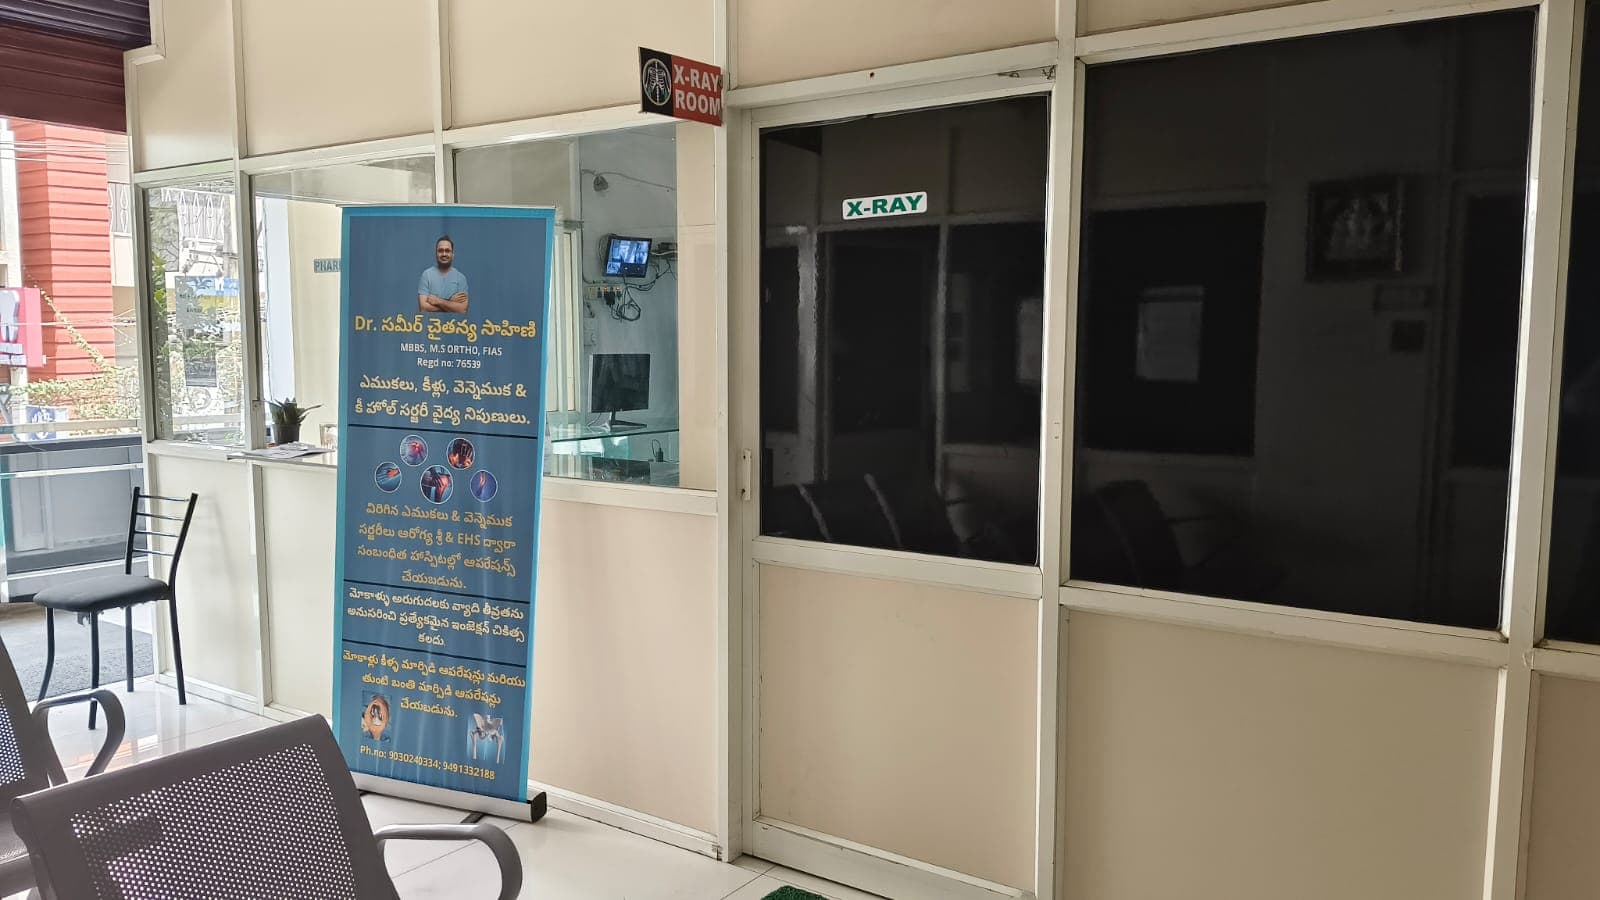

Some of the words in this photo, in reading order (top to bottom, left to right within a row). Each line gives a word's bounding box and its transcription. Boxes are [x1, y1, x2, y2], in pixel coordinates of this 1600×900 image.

[674, 65, 719, 91] X-RAY
[675, 89, 721, 116] ROOM
[846, 195, 923, 216] X-RAY
[314, 260, 341, 271] PHAR
[355, 316, 376, 331] Dr.
[381, 315, 424, 332] సమీర్
[427, 318, 477, 342] చైతన్య
[401, 343, 427, 353] MBBS,
[430, 345, 445, 353] M.S
[447, 345, 480, 356] ORTHO,
[483, 347, 502, 355] FIAS
[417, 358, 438, 368] Regd
[456, 360, 481, 368] 76539
[454, 380, 512, 400] వెన్నెముక
[516, 384, 527, 397] &
[433, 405, 460, 425] వైద్య
[452, 510, 460, 522] &
[445, 531, 454, 543] &
[458, 533, 480, 546] EHS
[360, 745, 387, 758] Ph.no:
[389, 751, 441, 769] 9030240334;
